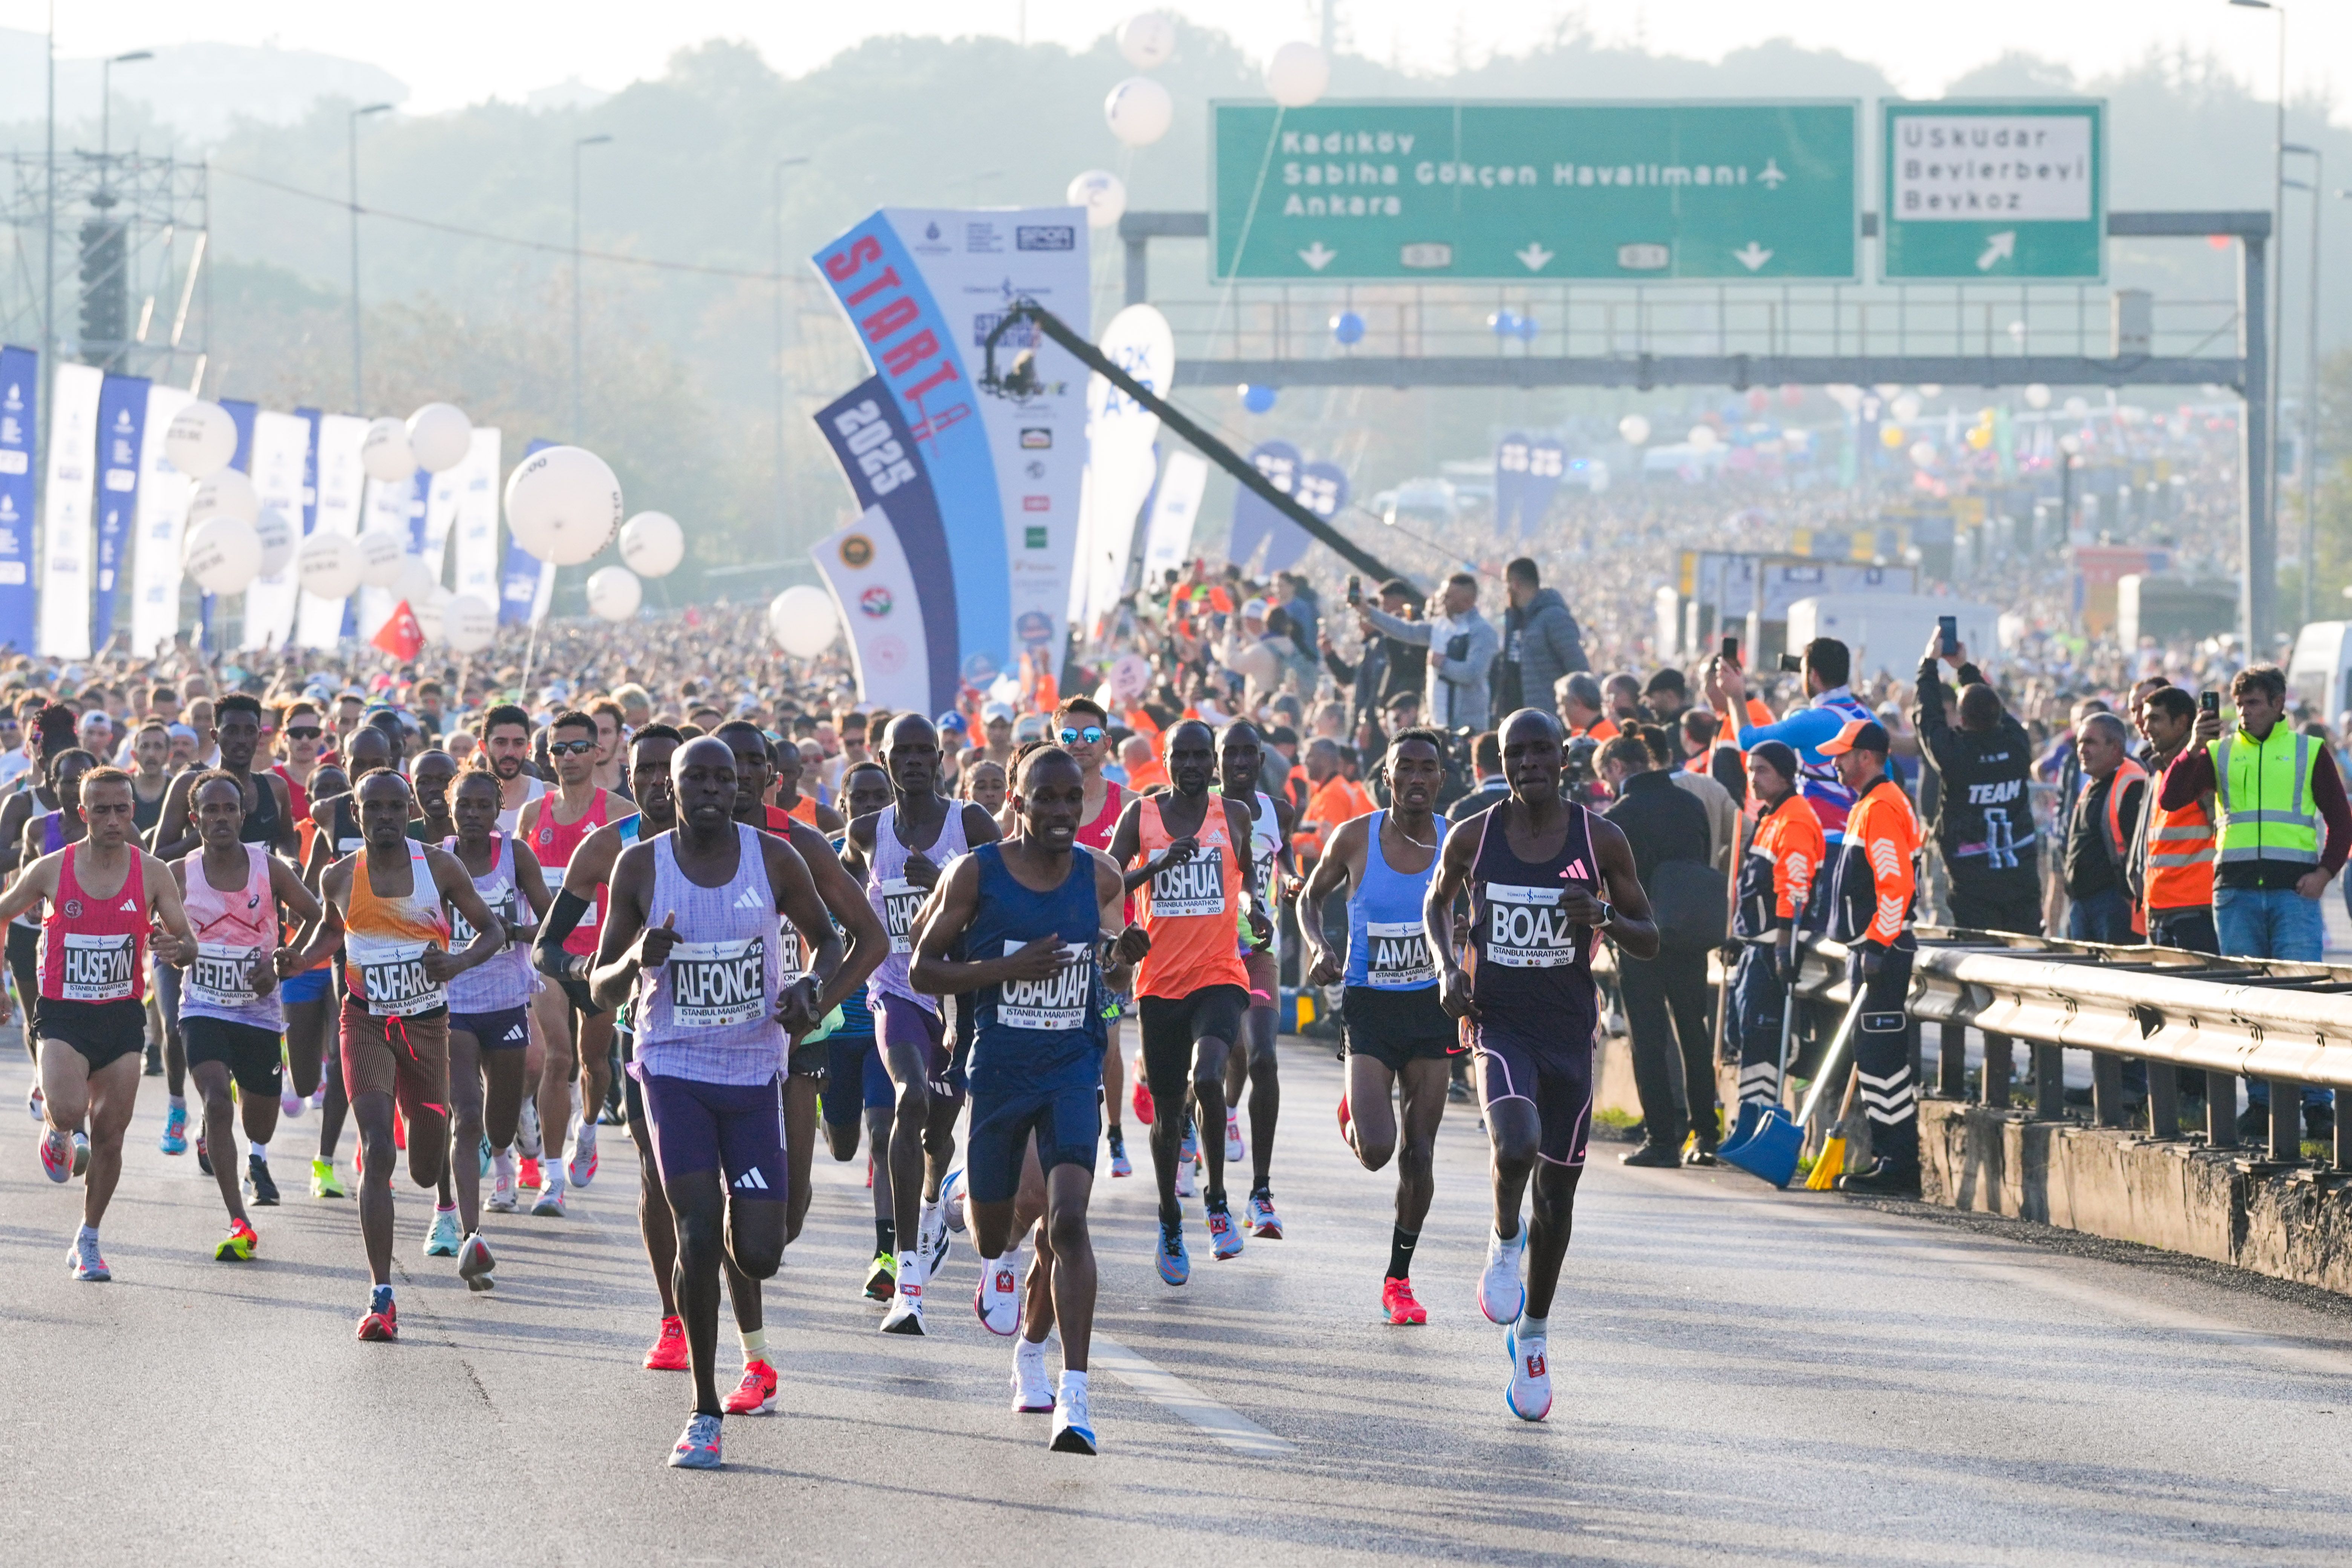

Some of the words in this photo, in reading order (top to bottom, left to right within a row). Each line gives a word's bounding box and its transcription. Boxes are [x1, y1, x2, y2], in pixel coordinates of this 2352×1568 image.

[1282, 132, 1415, 155] Kadıköy
[1283, 161, 1399, 185] Sabiha
[1553, 162, 1748, 186] Havalimanı
[1904, 154, 2084, 181] Beylerbeyi
[1283, 193, 1401, 216] Ankara
[1904, 190, 2020, 210] Beykoz
[825, 234, 960, 402] START
[833, 399, 917, 496] 2025
[1968, 779, 2022, 804] TEAM
[1211, 852, 1221, 861] 21
[1152, 864, 1221, 899] JOSHUA
[504, 892, 514, 903] 115
[787, 921, 797, 931] 9
[1492, 903, 1571, 947] BOAZ
[129, 938, 133, 947] 5
[750, 942, 763, 955] 92
[250, 951, 261, 959] 23
[1082, 949, 1092, 961] 93
[1494, 946, 1525, 957] ISTANBUL
[1526, 949, 1568, 957] MARATHON
[66, 949, 133, 983] HÜSEYİN
[98, 982, 128, 992] MARATHON
[676, 957, 761, 1006] ALFONCE
[198, 986, 219, 996] ISTANBUL
[404, 992, 436, 1007] MARATHON
[426, 1000, 439, 1009] 2025
[682, 1007, 718, 1016] ISTANBUL
[718, 1001, 758, 1015] MARATHON
[746, 1009, 761, 1020] 2025
[1006, 1008, 1044, 1017] ISTANBUL
[1044, 1009, 1081, 1018] MARATHON
[1069, 1018, 1081, 1027] 2025
